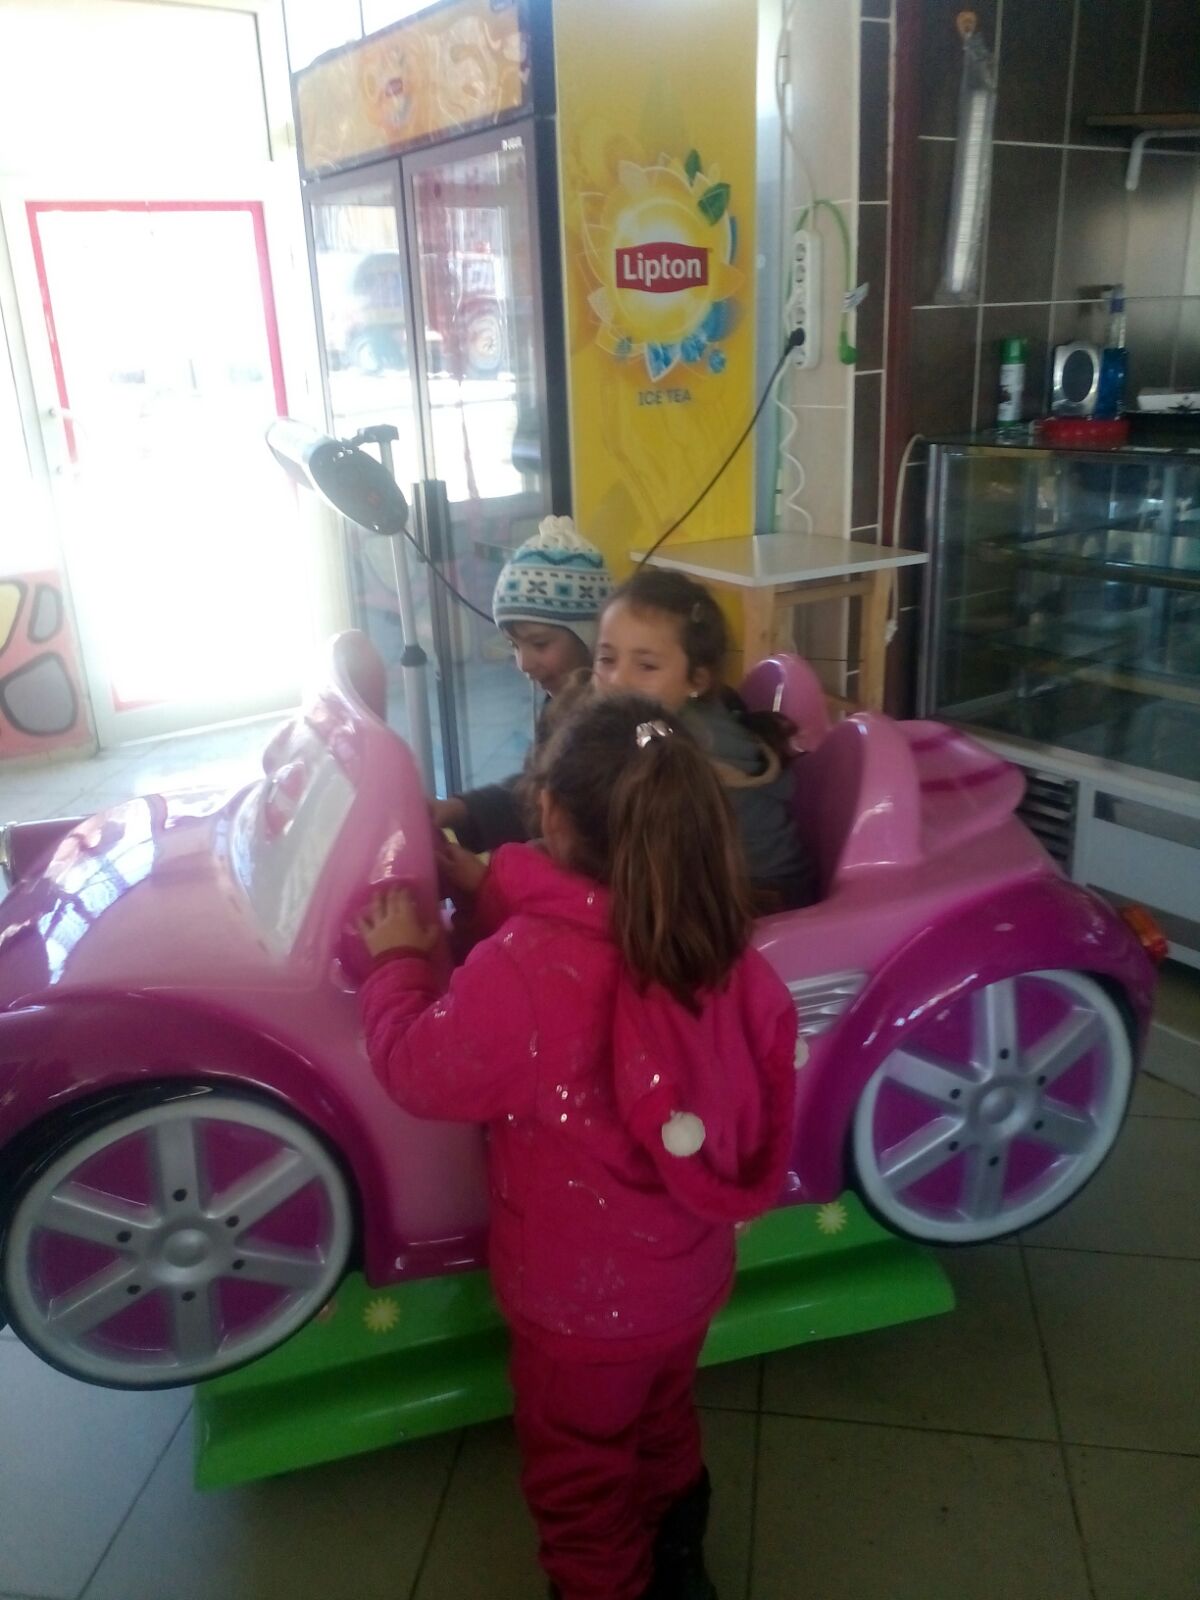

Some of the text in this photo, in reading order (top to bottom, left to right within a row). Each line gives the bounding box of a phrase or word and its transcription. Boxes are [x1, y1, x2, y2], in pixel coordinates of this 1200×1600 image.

[623, 252, 702, 287] Lipton
[638, 389, 692, 406] ICE TEA
